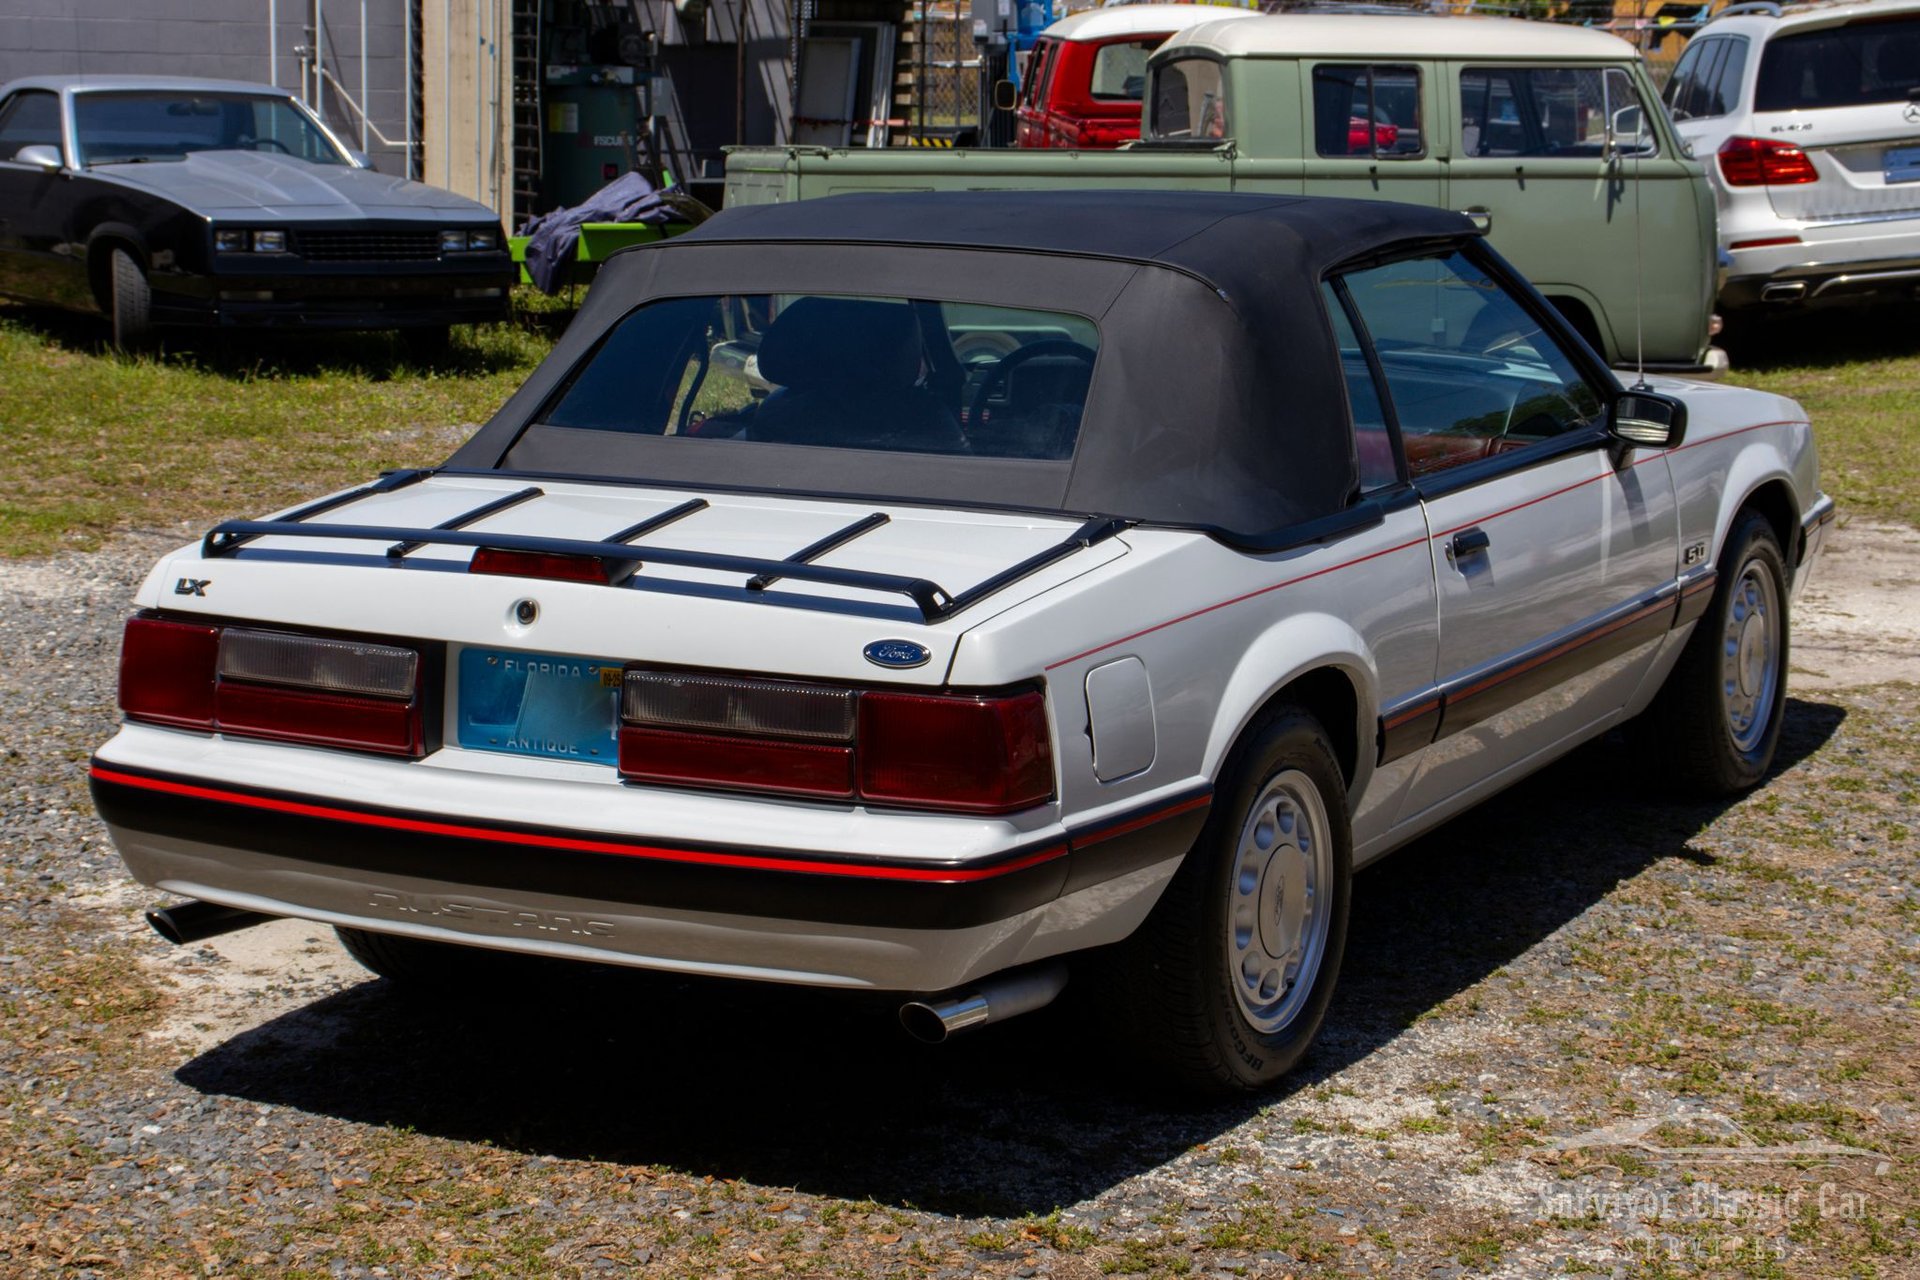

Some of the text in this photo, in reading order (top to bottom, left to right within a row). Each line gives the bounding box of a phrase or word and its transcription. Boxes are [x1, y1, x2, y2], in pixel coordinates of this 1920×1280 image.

[174, 578, 211, 597] LX
[878, 644, 915, 660] Ford
[504, 659, 581, 678] FLORIDA
[506, 737, 579, 755] ANTIQUE
